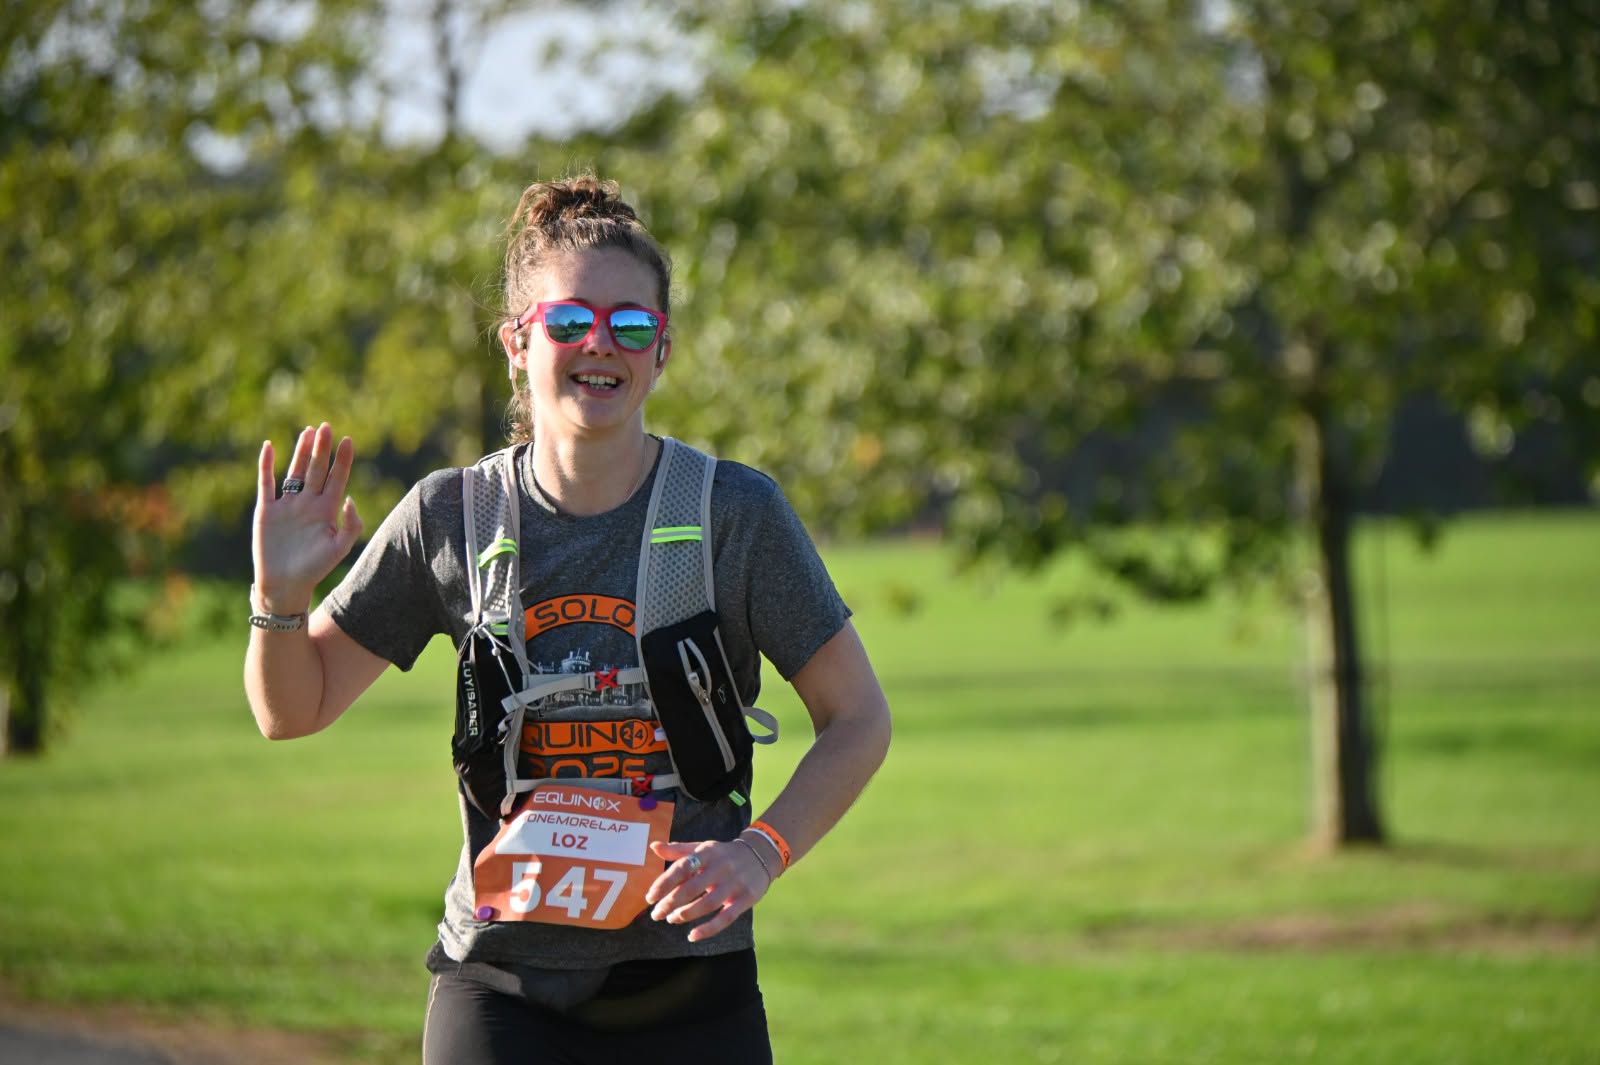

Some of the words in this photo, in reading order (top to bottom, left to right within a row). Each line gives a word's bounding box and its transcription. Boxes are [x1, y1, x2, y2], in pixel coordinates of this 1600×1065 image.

[534, 599, 636, 629] SOLO
[462, 660, 479, 736] LUYISABER
[533, 791, 622, 813] EQUINOX
[551, 832, 589, 850] LOZ
[509, 861, 629, 921] 547
